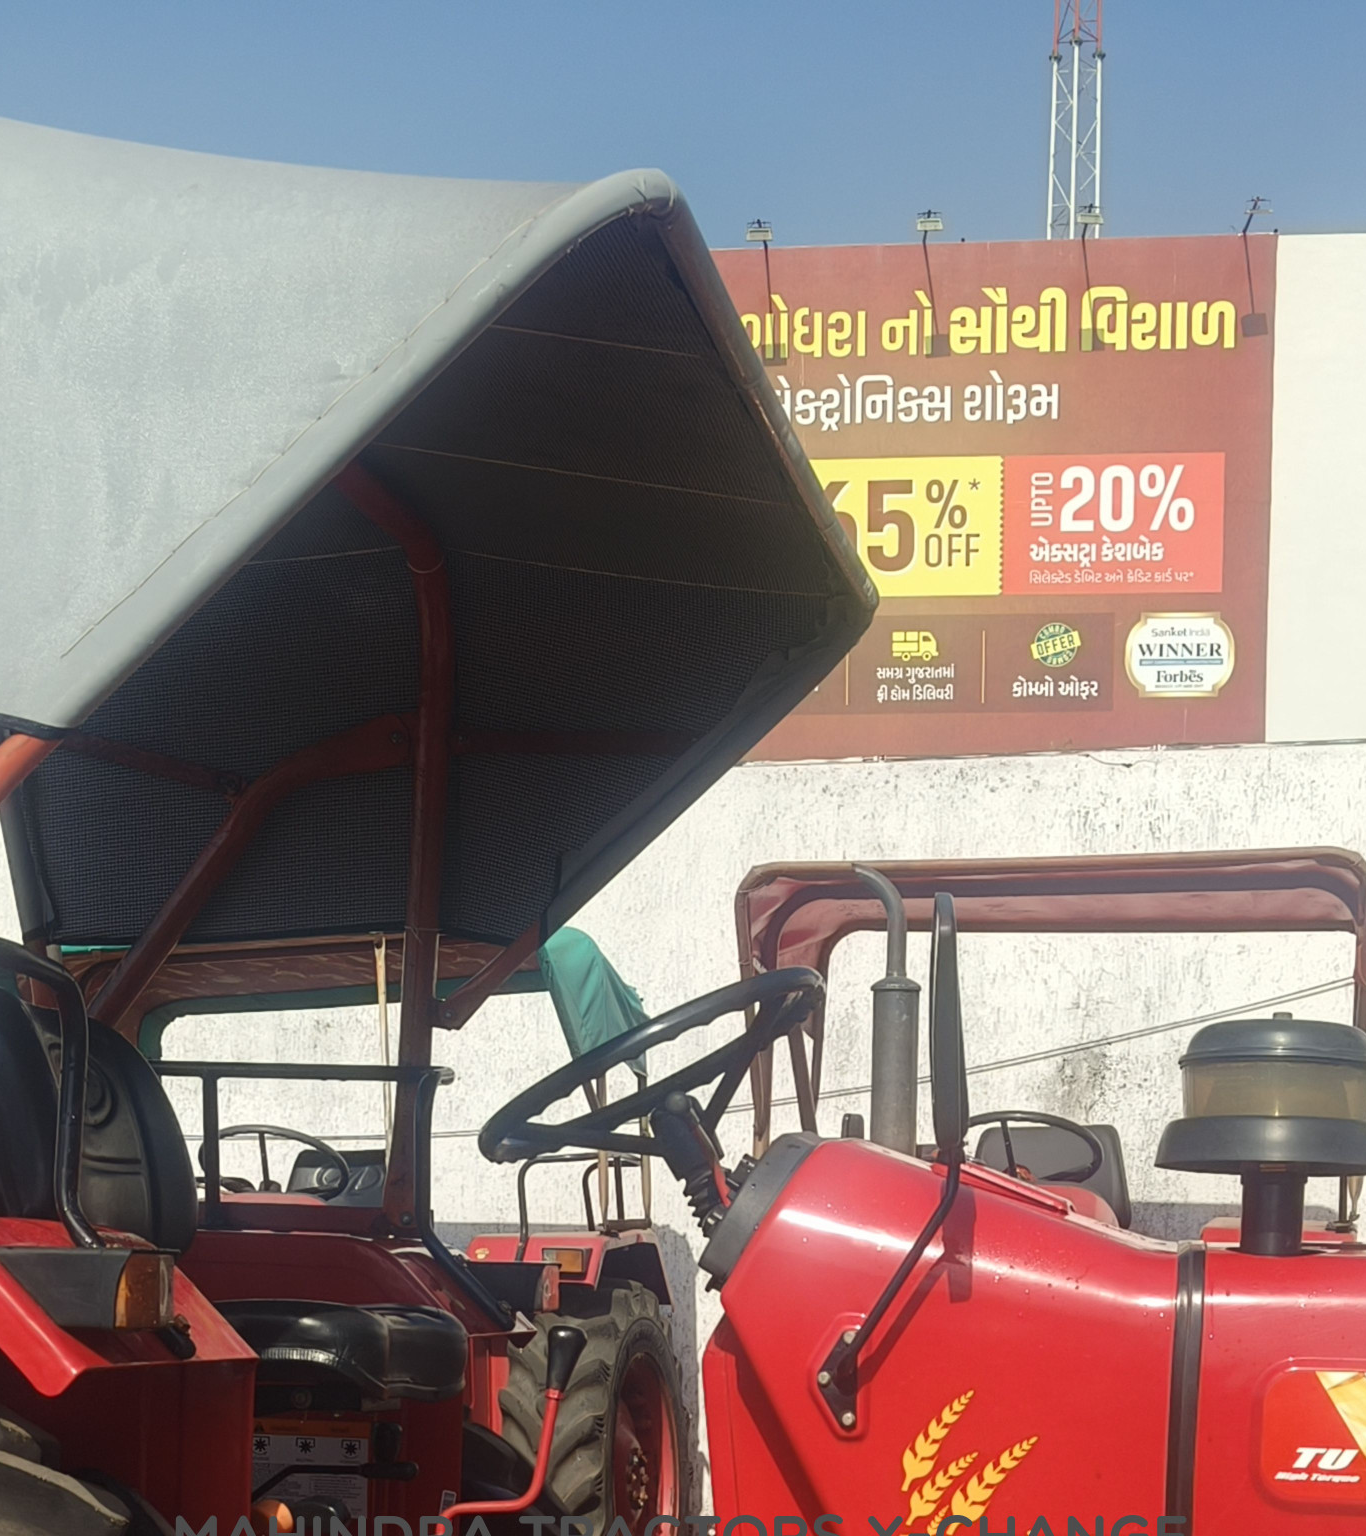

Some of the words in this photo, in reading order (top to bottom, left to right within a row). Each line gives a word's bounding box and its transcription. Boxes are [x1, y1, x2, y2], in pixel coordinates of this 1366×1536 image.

[880, 289, 933, 356] નો
[948, 286, 1067, 354] સૌથી
[1080, 285, 1236, 351] વિશાળ
[963, 369, 1059, 424] શોરૂમ
[1030, 472, 1054, 527] UPTO
[1060, 463, 1195, 532] 20%
[924, 533, 981, 568] OFF
[1101, 535, 1165, 562] કેશબેક
[1036, 633, 1076, 656] OFFER
[1151, 626, 1187, 638] Sanket
[1138, 642, 1223, 657] WINNER
[1057, 674, 1099, 700] ઓફર
[1156, 669, 1204, 683] Forbes
[890, 684, 910, 701] હોમ
[912, 683, 954, 701] ડિલિવરી
[1292, 1447, 1360, 1471] TU
